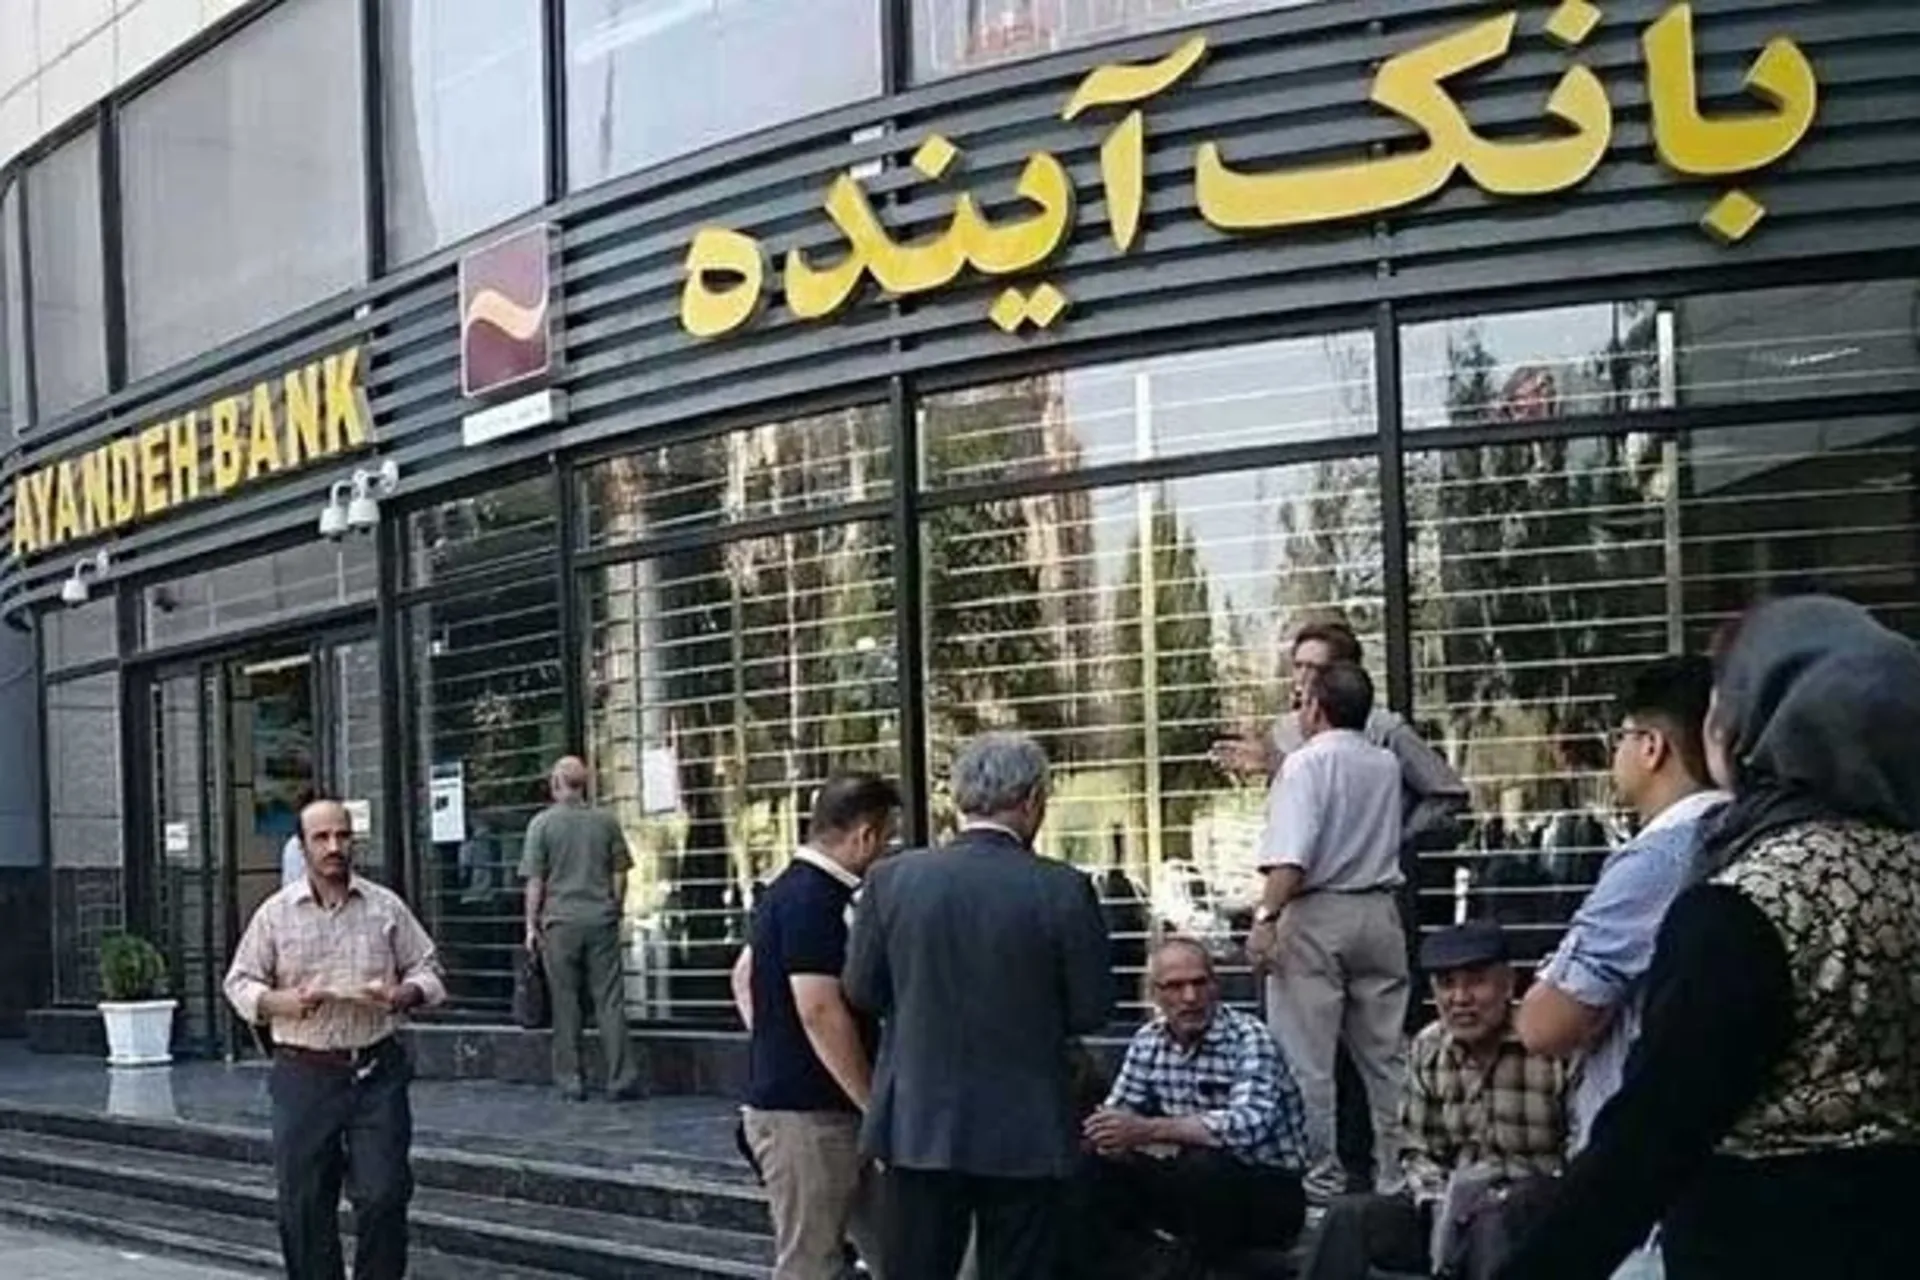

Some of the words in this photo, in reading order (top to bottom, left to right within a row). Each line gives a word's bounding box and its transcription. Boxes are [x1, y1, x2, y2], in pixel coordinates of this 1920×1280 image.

[680, 35, 1208, 337] آینده
[1195, 0, 1818, 243] بانک
[12, 409, 199, 557] AYANDEH
[211, 346, 368, 492] BANK
